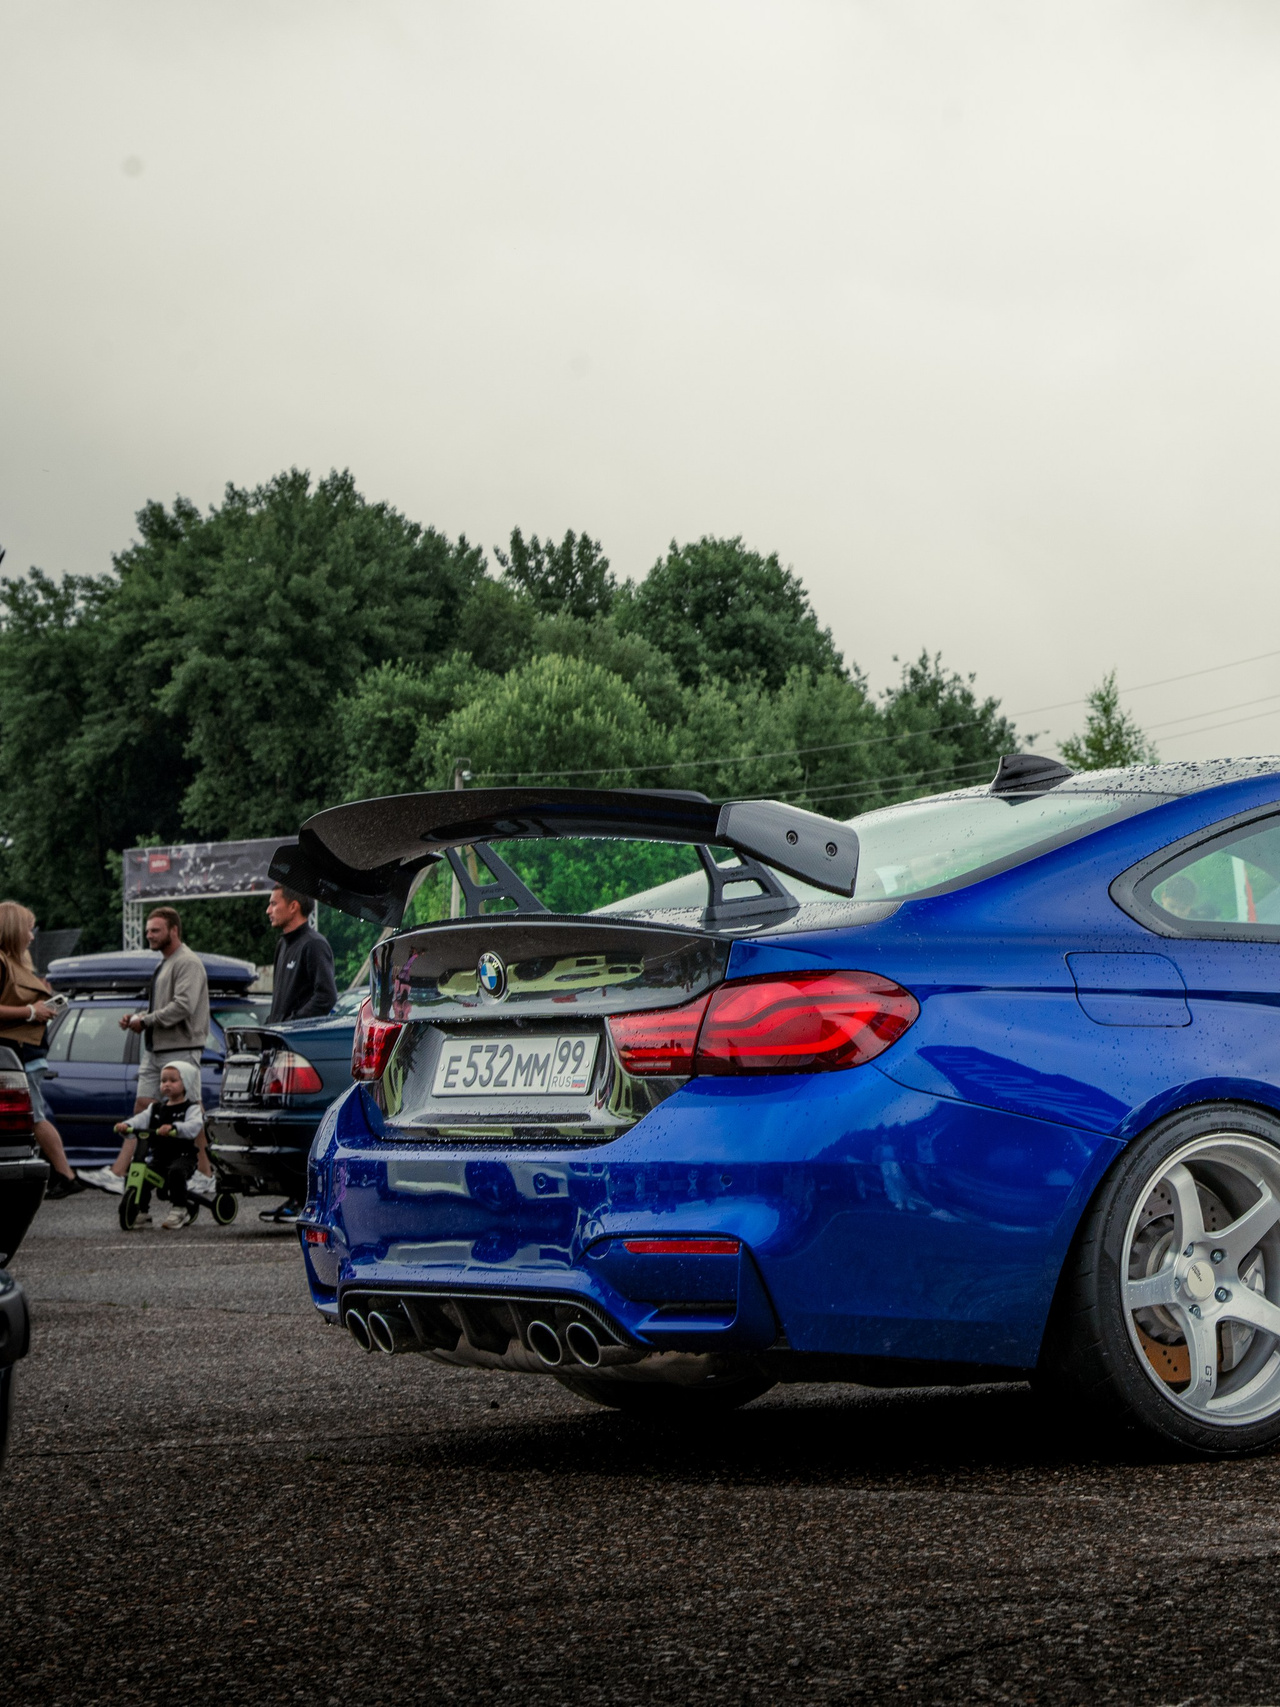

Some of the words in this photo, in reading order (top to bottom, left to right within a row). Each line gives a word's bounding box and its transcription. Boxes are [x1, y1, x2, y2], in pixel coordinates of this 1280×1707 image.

[557, 1040, 586, 1075] 99
[551, 1076, 571, 1088] RUS
[1204, 1365, 1213, 1387] GT
